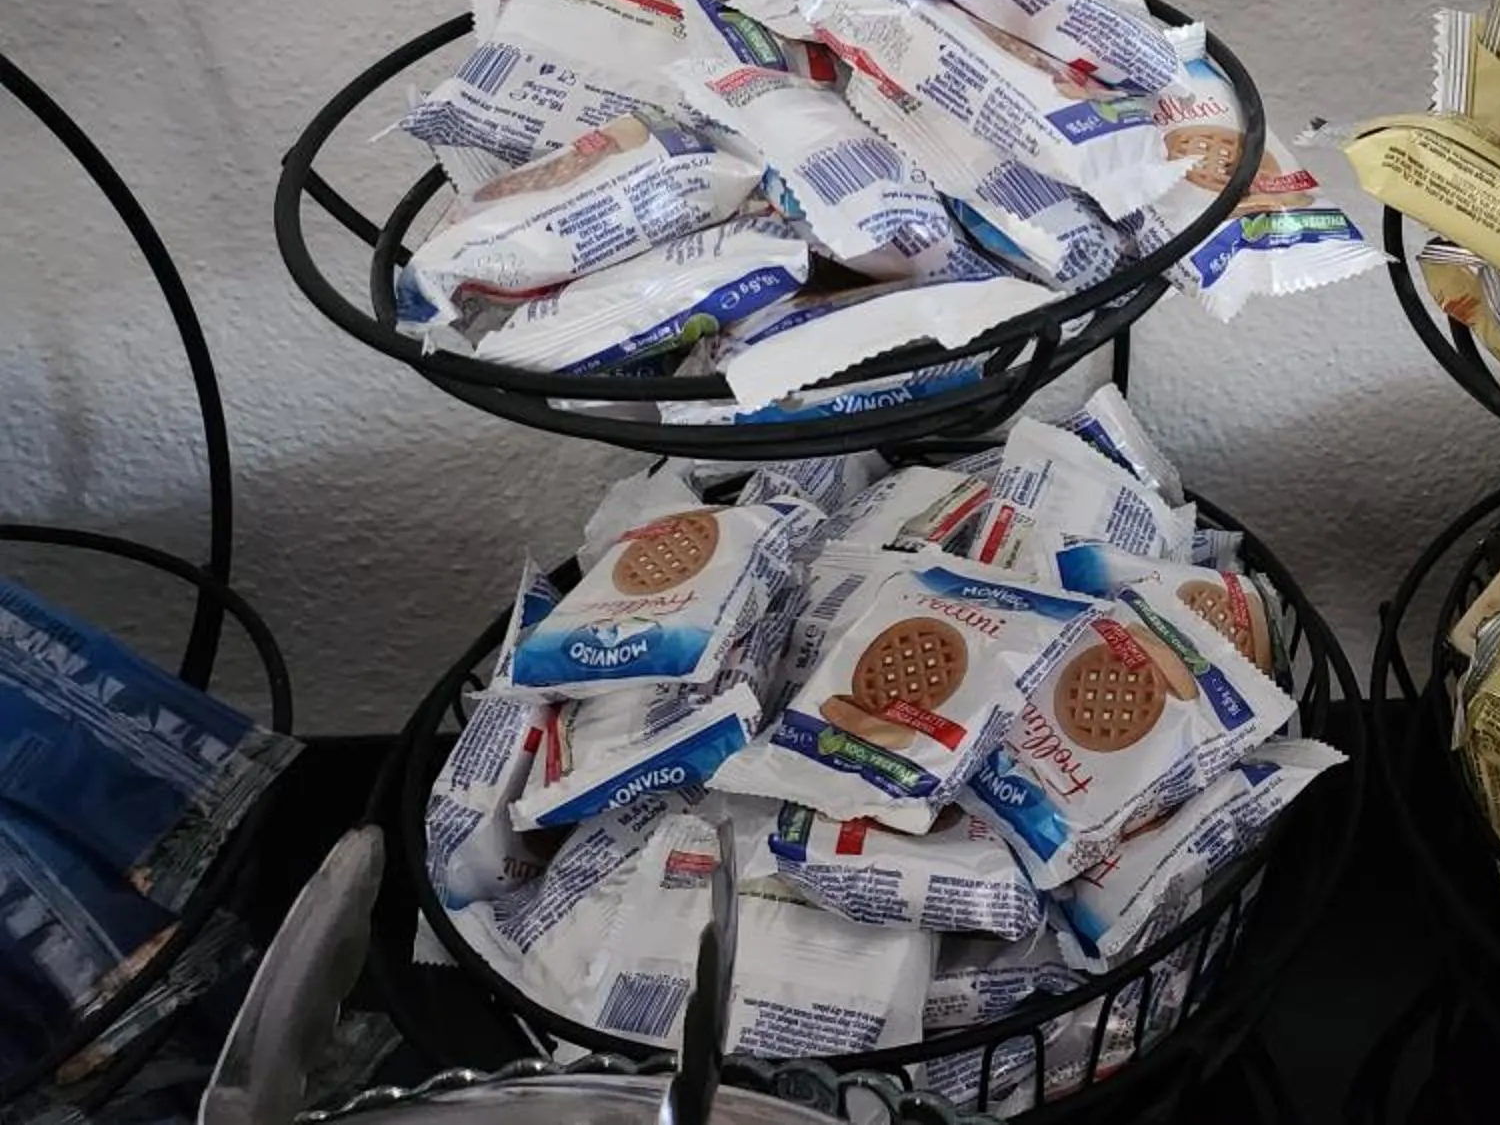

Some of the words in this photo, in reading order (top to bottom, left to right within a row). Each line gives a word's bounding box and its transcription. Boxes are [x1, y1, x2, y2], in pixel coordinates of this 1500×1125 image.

[831, 387, 913, 414] MONVIS
[568, 639, 648, 668] MONVISO
[1022, 701, 1094, 801] Frollin
[979, 767, 1027, 806] MONVI
